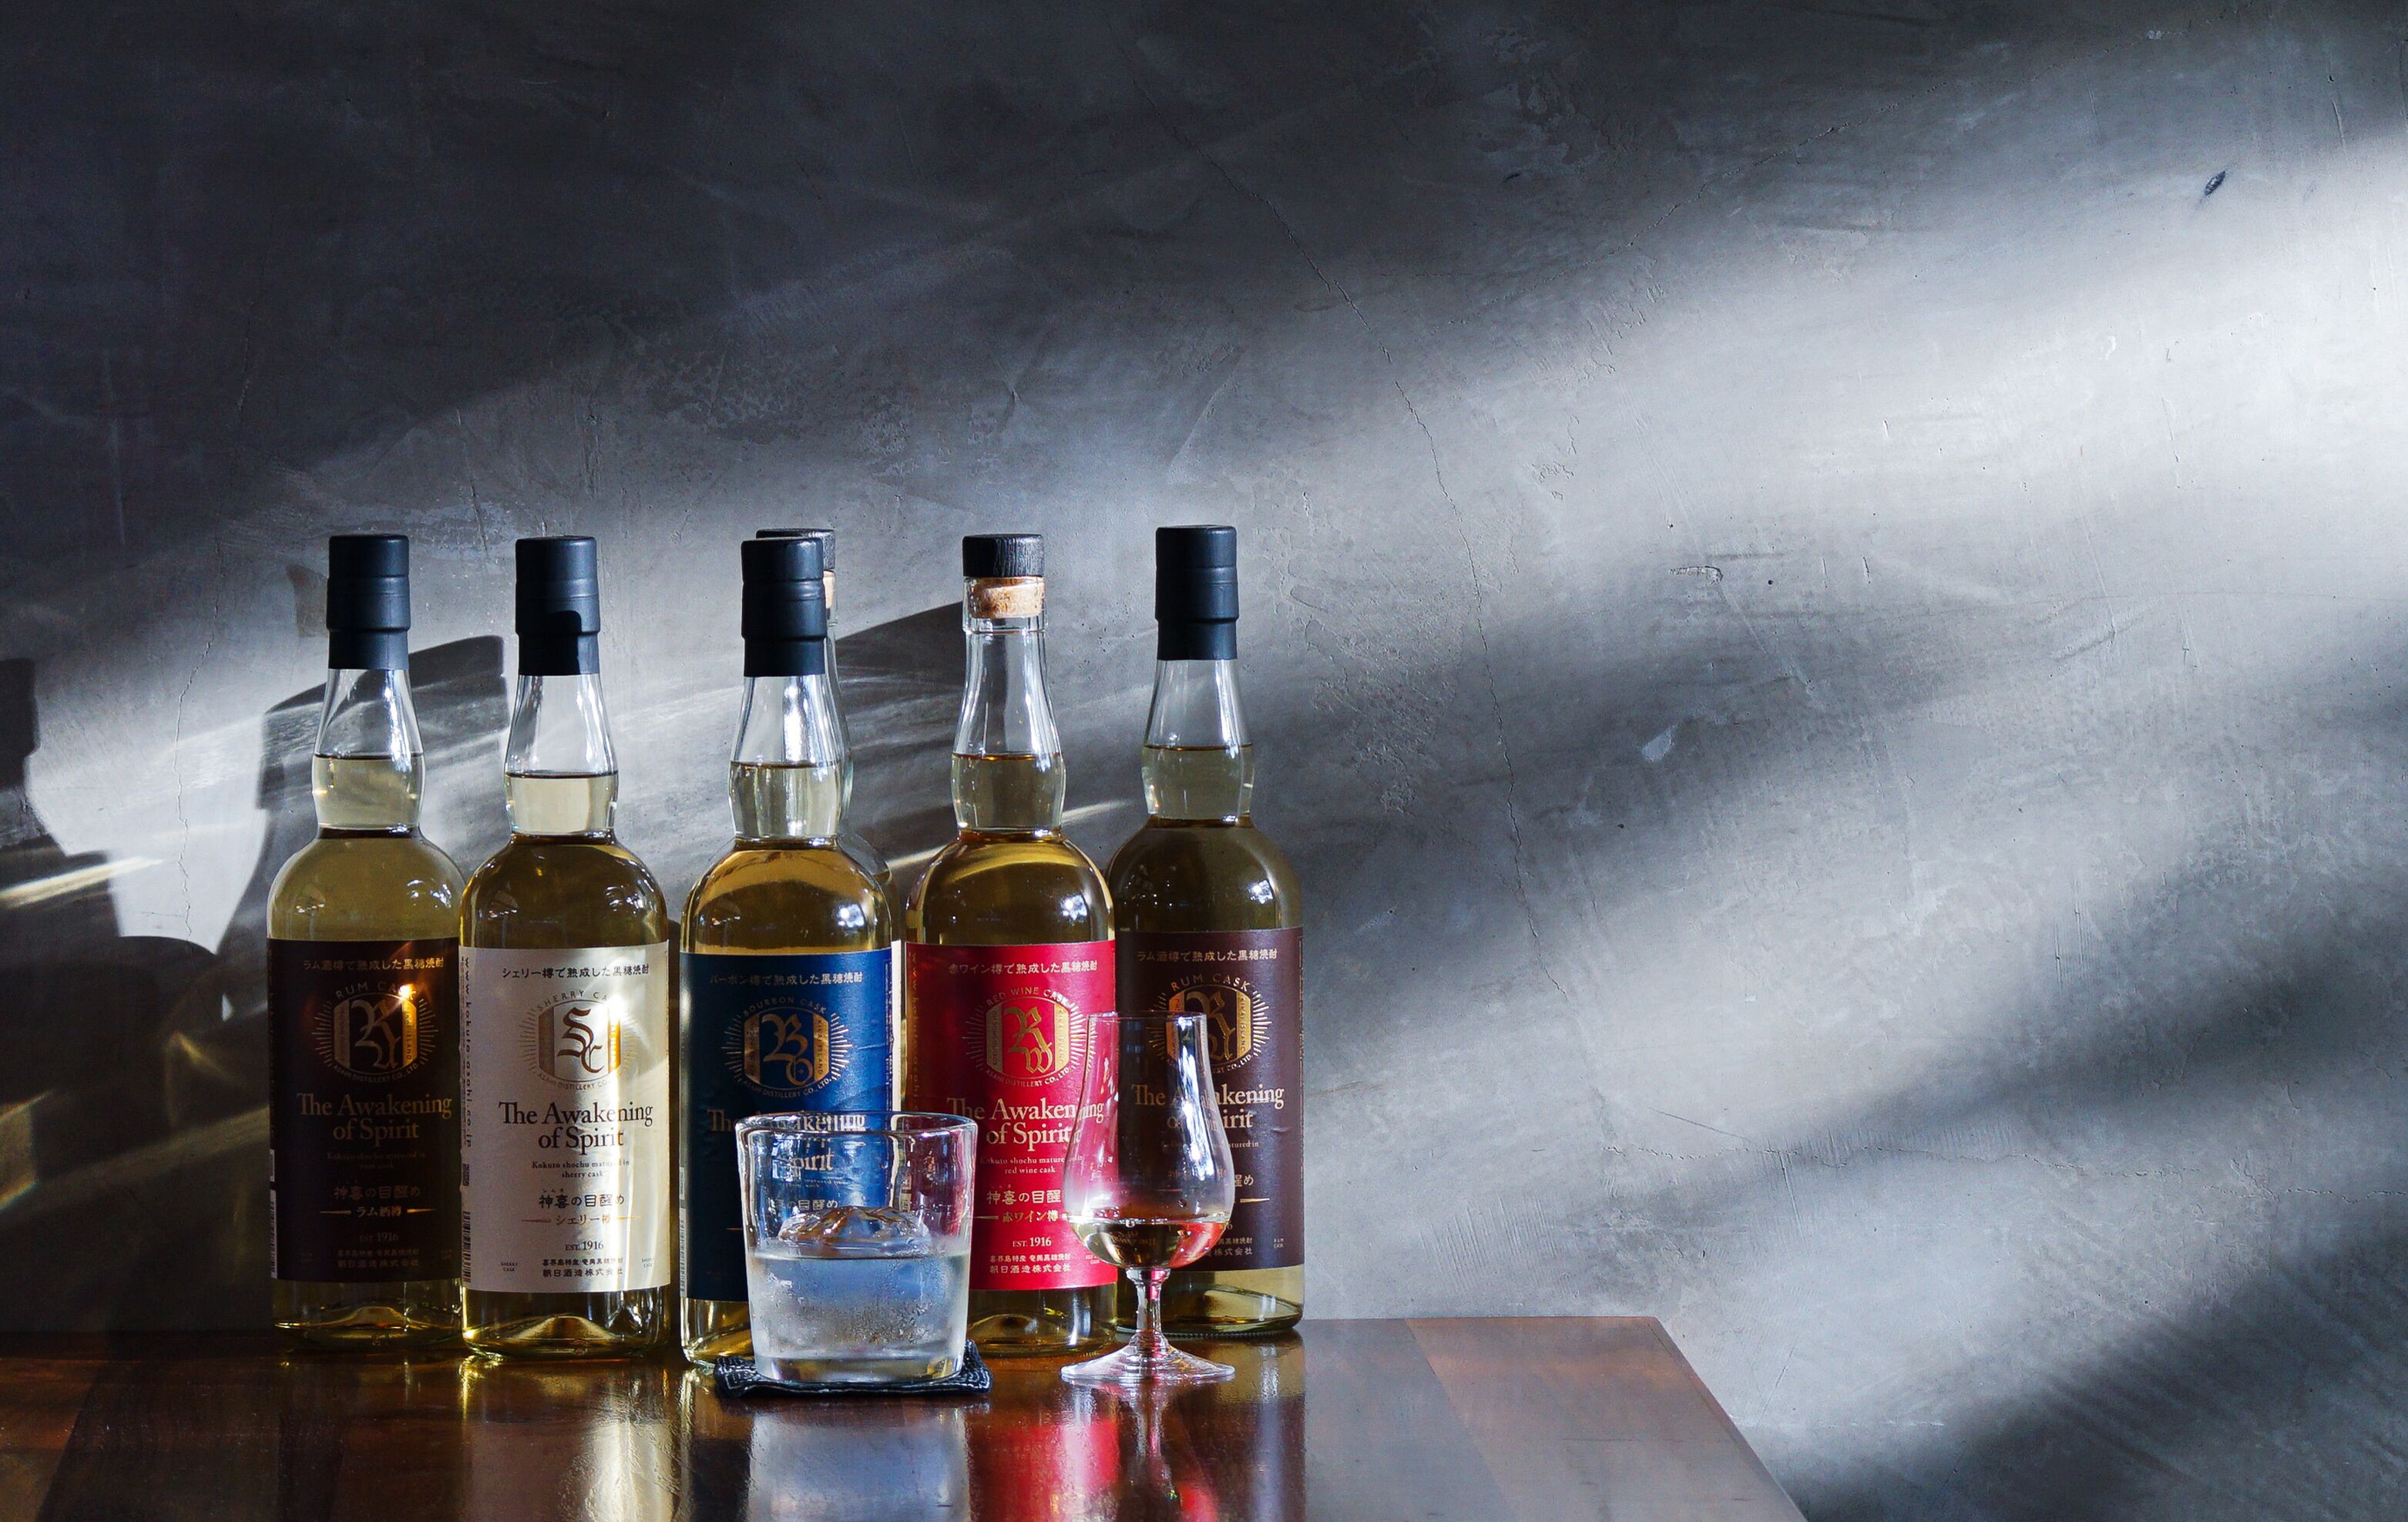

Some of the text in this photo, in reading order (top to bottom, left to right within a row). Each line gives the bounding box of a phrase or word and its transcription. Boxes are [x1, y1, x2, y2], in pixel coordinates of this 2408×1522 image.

[336, 982, 369, 999] RUM
[1171, 973, 1251, 992] RUM CASK
[538, 990, 584, 1012] SHERRY
[743, 996, 826, 1016] BOURBON CASK
[986, 992, 1006, 1006] RED
[1011, 986, 1039, 996] WINE
[1131, 1084, 1166, 1106] The
[297, 1093, 453, 1120] The Awakening
[498, 1101, 653, 1127] The Awakening
[946, 1097, 985, 1120] The
[1224, 1108, 1254, 1129] irit
[333, 1118, 420, 1148] of Spirit
[539, 1126, 625, 1156] of Spirit
[986, 1123, 1073, 1151] of Spirit
[562, 1160, 589, 1168] shochu
[986, 1189, 1063, 1205] 神喜の目醒
[376, 1232, 399, 1241] 1916
[583, 1240, 604, 1251] 1916
[1029, 1236, 1053, 1247] 1916
